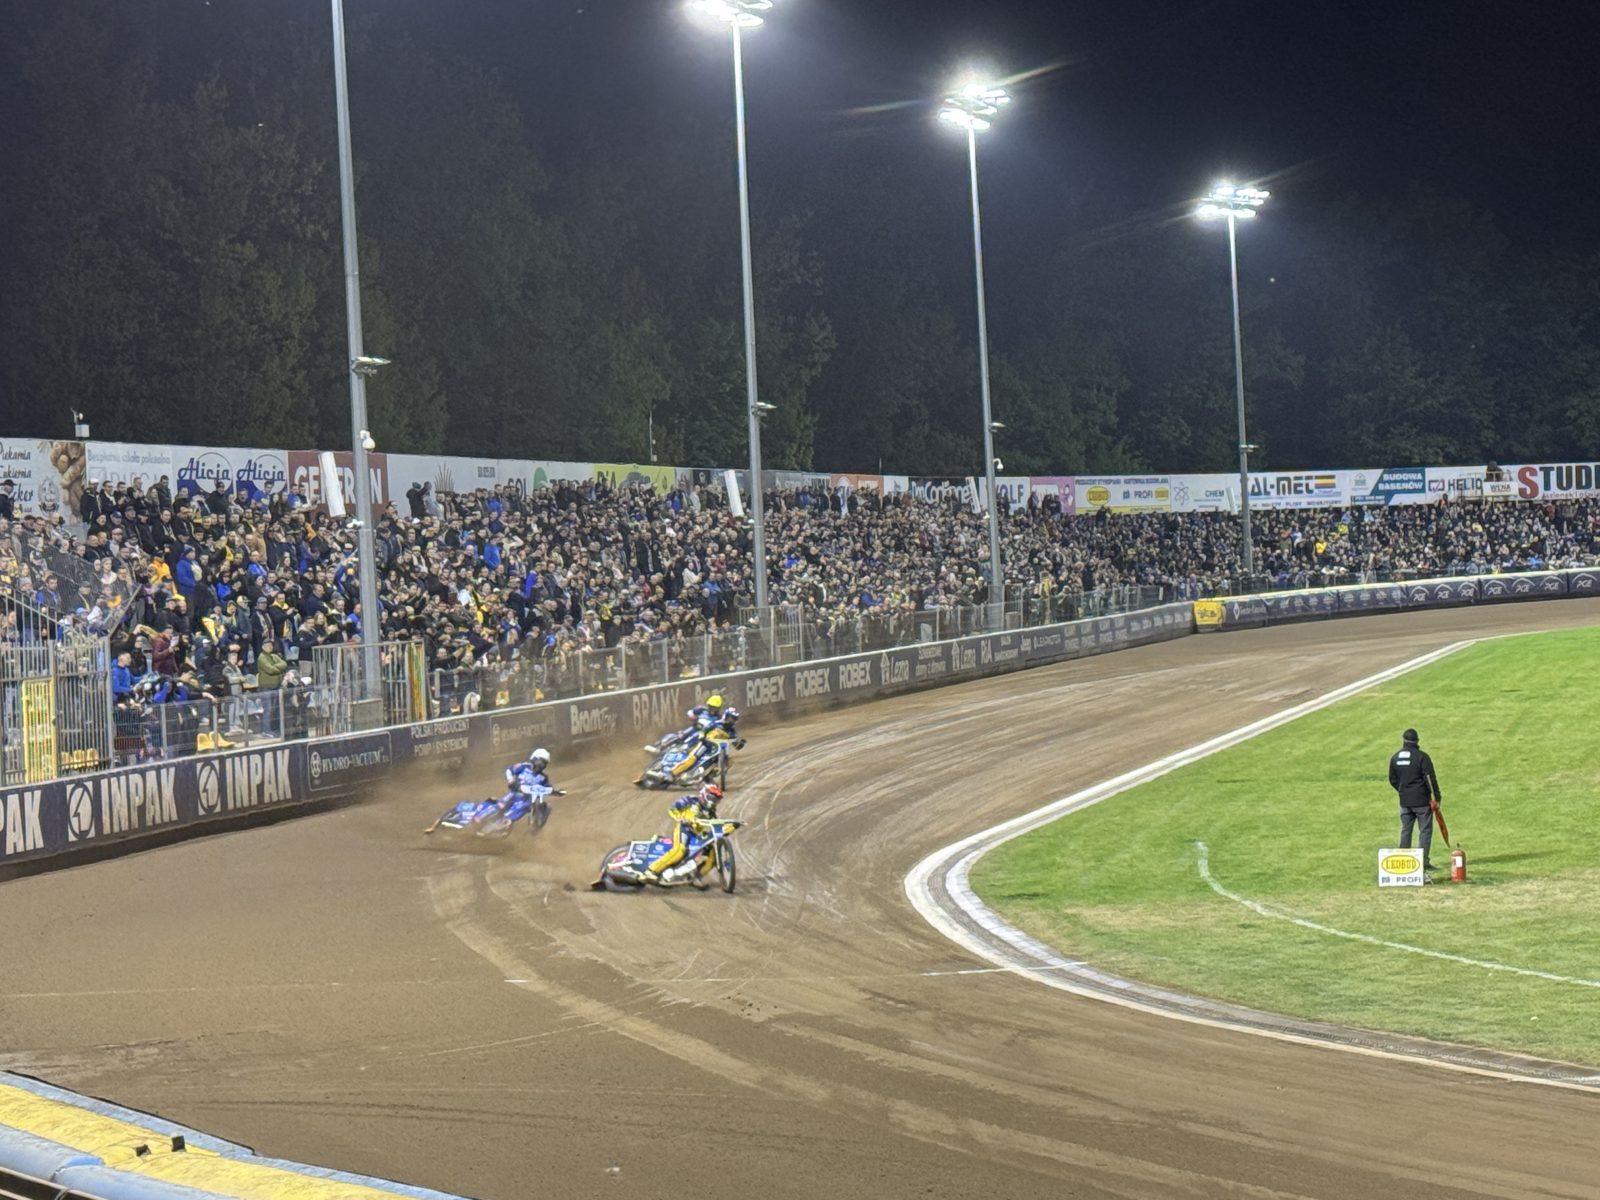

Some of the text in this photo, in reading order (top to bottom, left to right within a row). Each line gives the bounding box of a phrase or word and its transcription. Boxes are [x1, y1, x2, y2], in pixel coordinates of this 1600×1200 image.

[177, 457, 231, 485] Alicja
[236, 459, 286, 483] Alicja
[1378, 481, 1424, 490] BASENÓW
[1383, 472, 1423, 481] BUDOWA
[746, 674, 786, 708] ROBEX
[795, 667, 831, 698] ROBEX
[839, 660, 872, 691] ROBEX
[633, 687, 680, 731] BRAMY
[226, 748, 293, 811] INPAK
[101, 766, 179, 836] INPAK
[0, 789, 45, 855] AK
